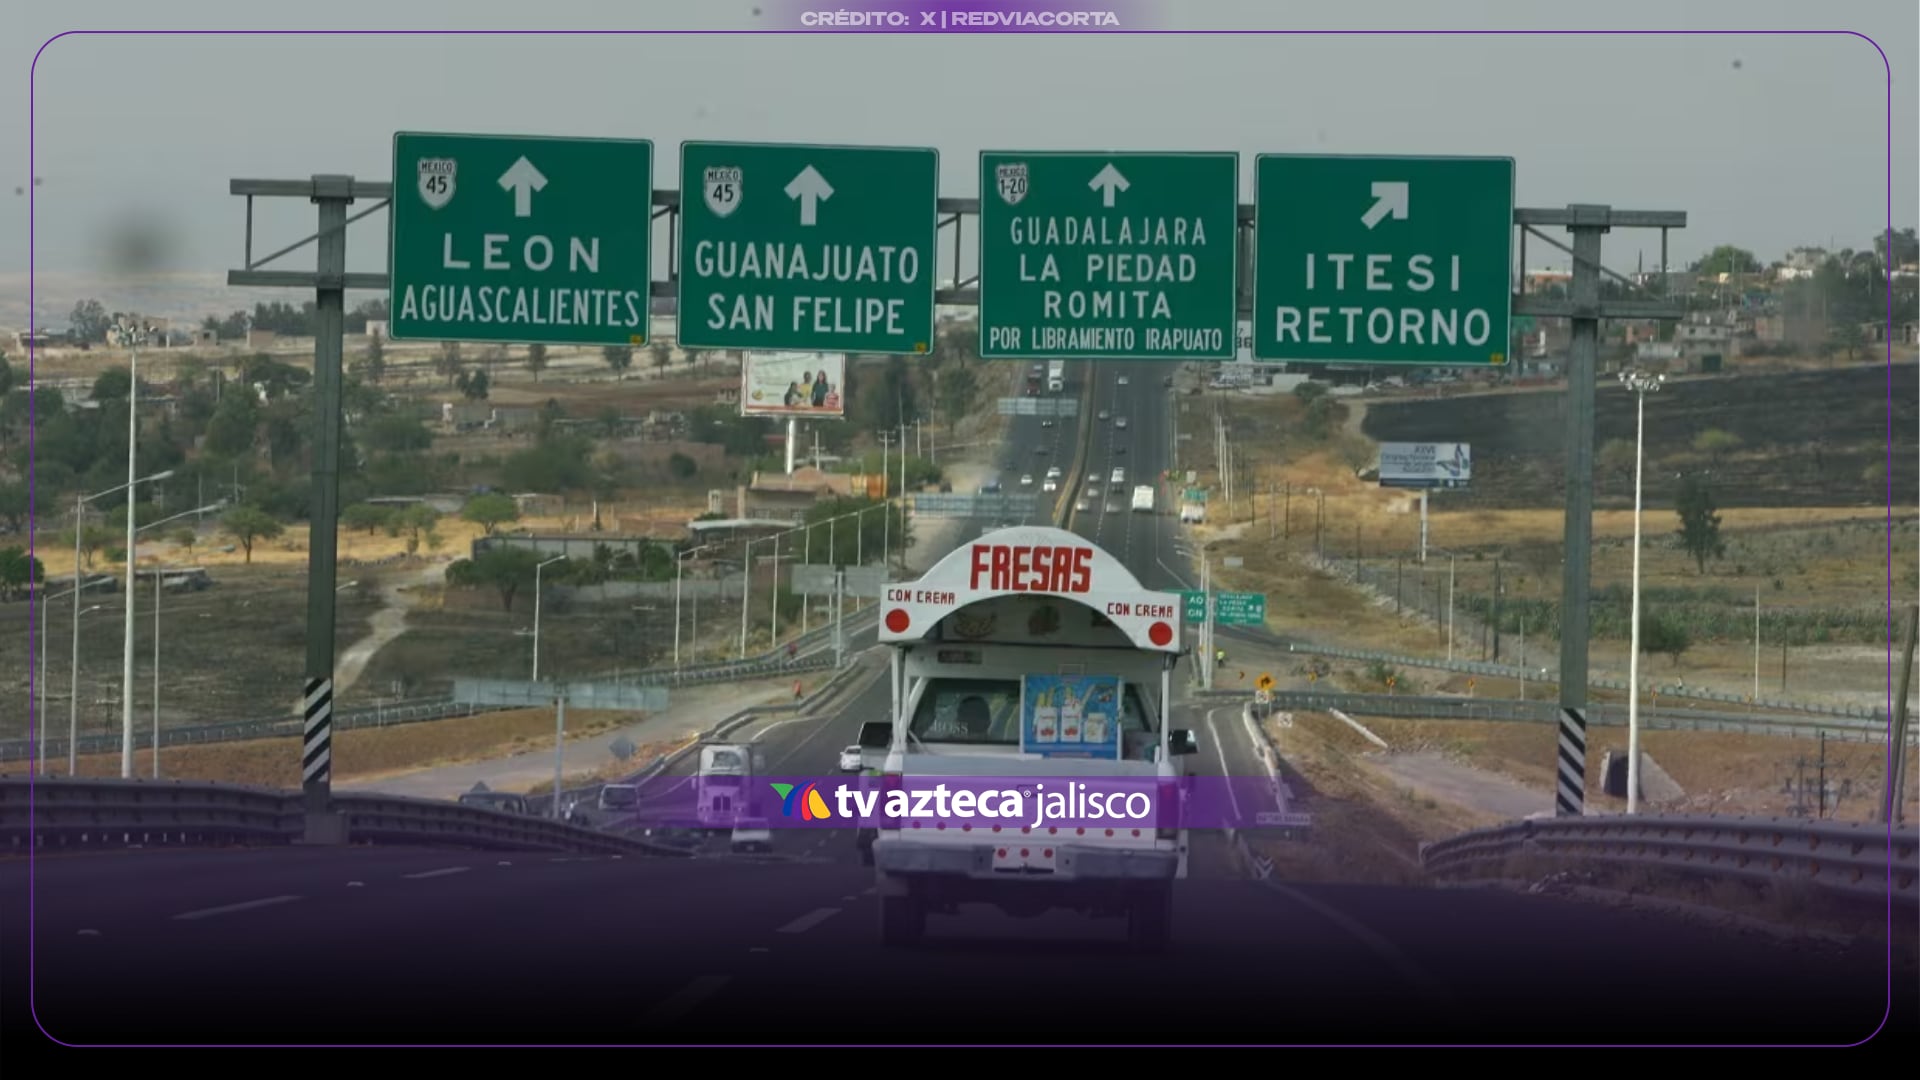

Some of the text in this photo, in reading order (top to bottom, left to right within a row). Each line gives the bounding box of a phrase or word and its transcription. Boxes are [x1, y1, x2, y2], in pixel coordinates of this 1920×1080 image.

[426, 175, 447, 194] 45
[712, 183, 734, 203] 45
[1000, 178, 1026, 195] 1-20
[1010, 216, 1206, 246] GUADALAJARA
[443, 232, 599, 273] LEON
[695, 240, 919, 284] GUANAJUATO
[1020, 253, 1196, 283] LA PIEDAD
[1306, 253, 1459, 292] ITESI
[400, 284, 640, 328] AGUASCALIENTES
[707, 292, 905, 335] SAN FELIPE
[1044, 290, 1171, 319] ROMITA
[989, 326, 1222, 351] POR LIBRAMIENTO IRAPUATO
[1276, 306, 1491, 346] RETORNO
[970, 544, 1093, 593] FRESAS
[887, 589, 956, 605] CON CREMA
[1107, 602, 1174, 618] CON CREMA
